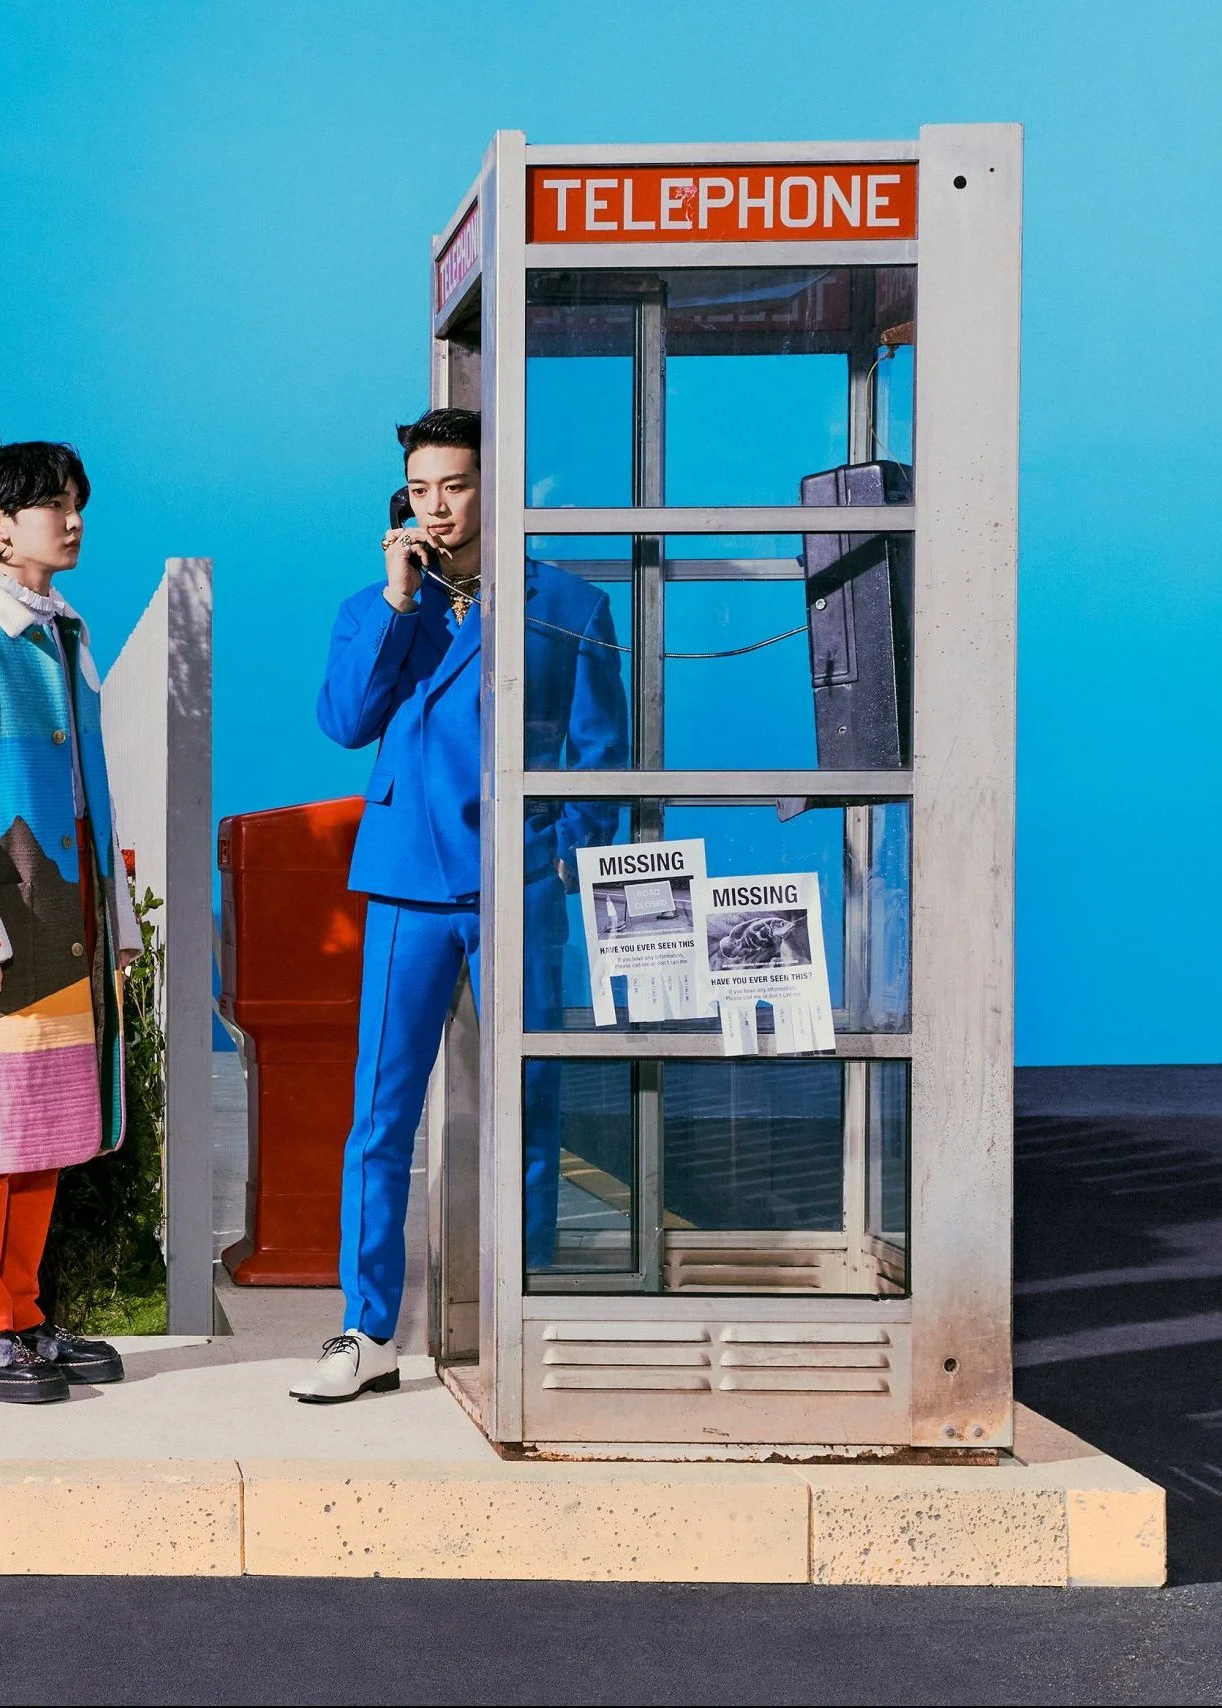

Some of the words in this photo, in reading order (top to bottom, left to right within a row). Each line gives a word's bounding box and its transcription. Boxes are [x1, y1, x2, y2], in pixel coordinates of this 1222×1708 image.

[542, 174, 901, 232] TELEPHONE
[599, 852, 684, 876] MISSING
[712, 884, 798, 907] MISSING
[600, 946, 619, 954] HAVE
[636, 943, 655, 951] EVER
[678, 940, 695, 948] THIS
[791, 972, 813, 980] THIS?
